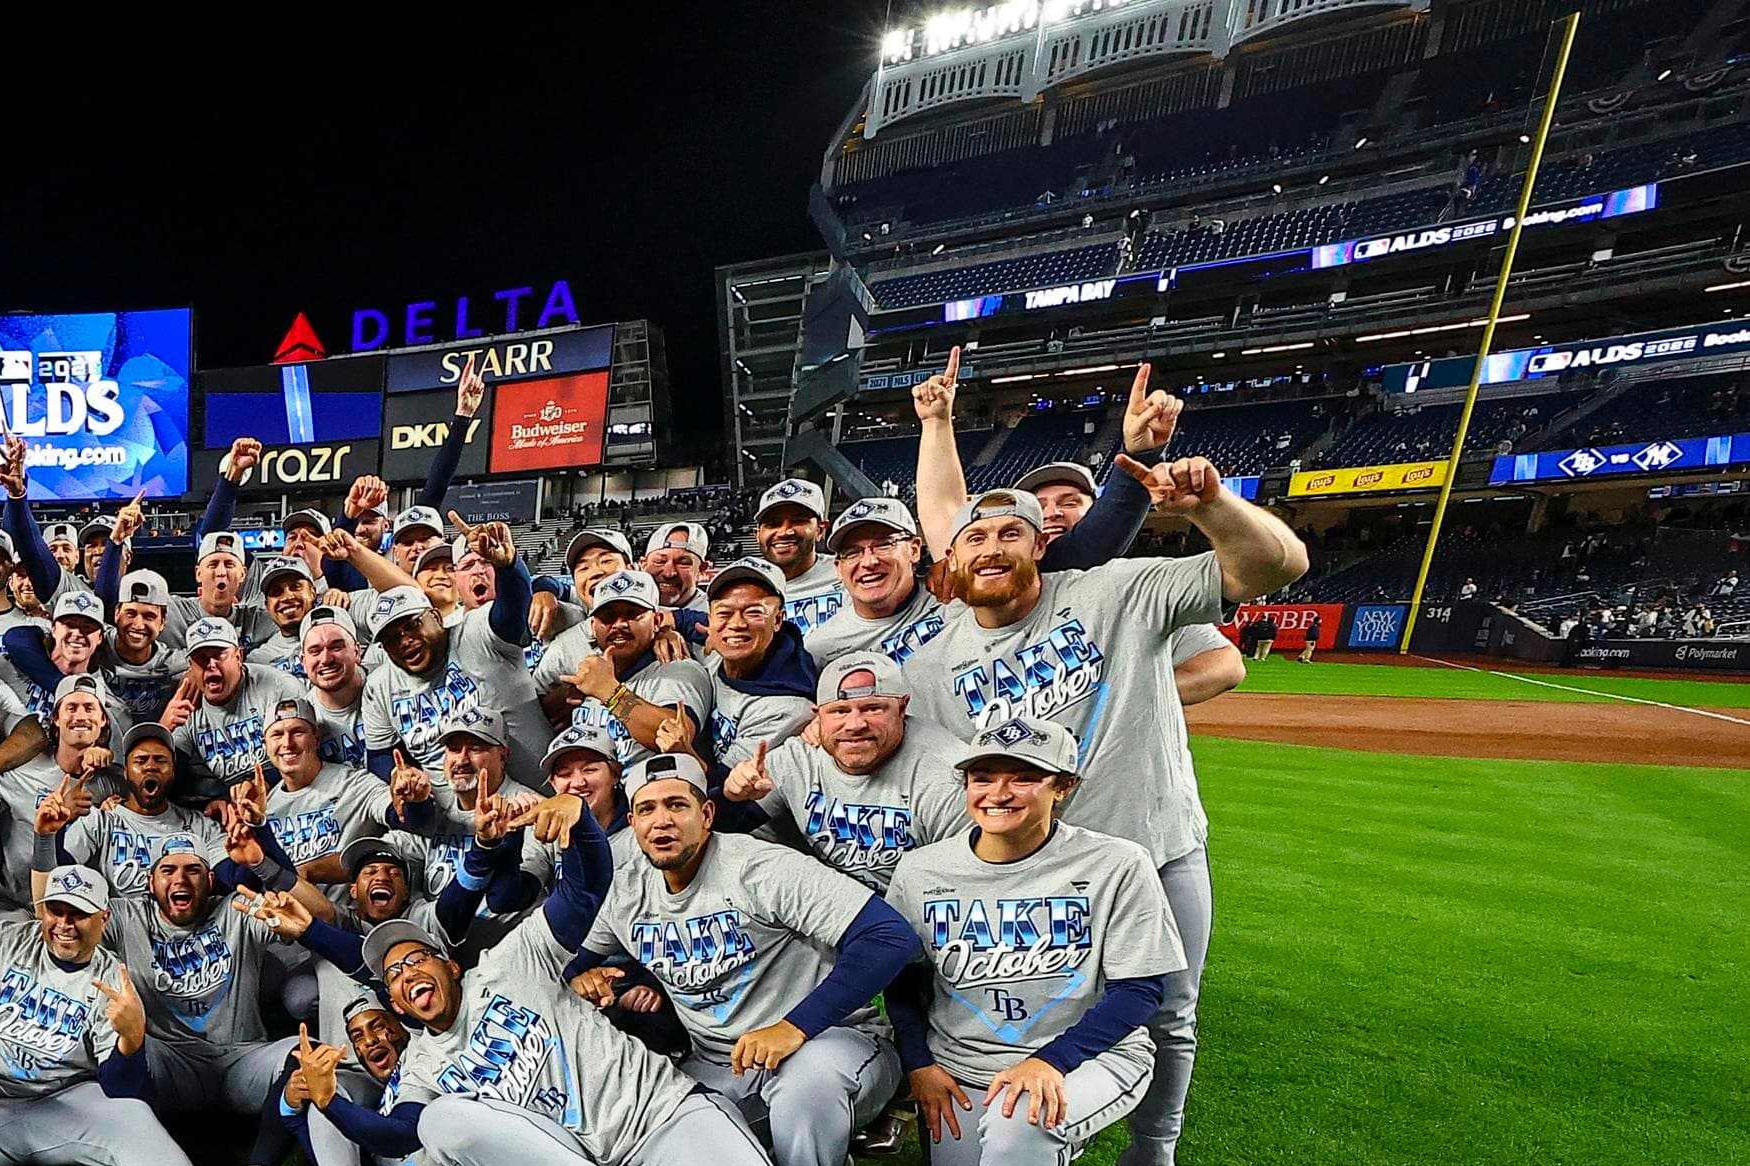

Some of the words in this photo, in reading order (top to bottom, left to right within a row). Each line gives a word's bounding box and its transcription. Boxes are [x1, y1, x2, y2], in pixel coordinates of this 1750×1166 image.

[1388, 227, 1451, 252] ALDS
[1025, 285, 1078, 310] TAMPA
[1079, 279, 1116, 302] BAY
[352, 279, 579, 351] DELTA
[440, 340, 554, 384] STARR
[1569, 342, 1645, 368] ALDS
[510, 421, 588, 440] Budweiser
[260, 446, 351, 484] razr
[466, 513, 485, 523] THE
[486, 511, 511, 521] BOSS
[783, 592, 843, 636] KE
[1356, 620, 1396, 633] YORK
[1361, 611, 1396, 623] NEW
[1425, 607, 1452, 619] 314
[880, 614, 945, 668] KE
[1357, 630, 1389, 642] LIFE
[1580, 645, 1630, 661] ooking.com
[1687, 646, 1738, 660] Polymarket
[952, 619, 1105, 722] TAKE
[196, 714, 264, 761] TAKE
[804, 789, 916, 851] TAKE
[631, 909, 756, 968] TAKE
[923, 896, 1093, 952] TAKE
[152, 956, 233, 996] October
[935, 933, 1091, 984] October
[984, 987, 1029, 1022] TB
[436, 992, 543, 1094] TAKE
